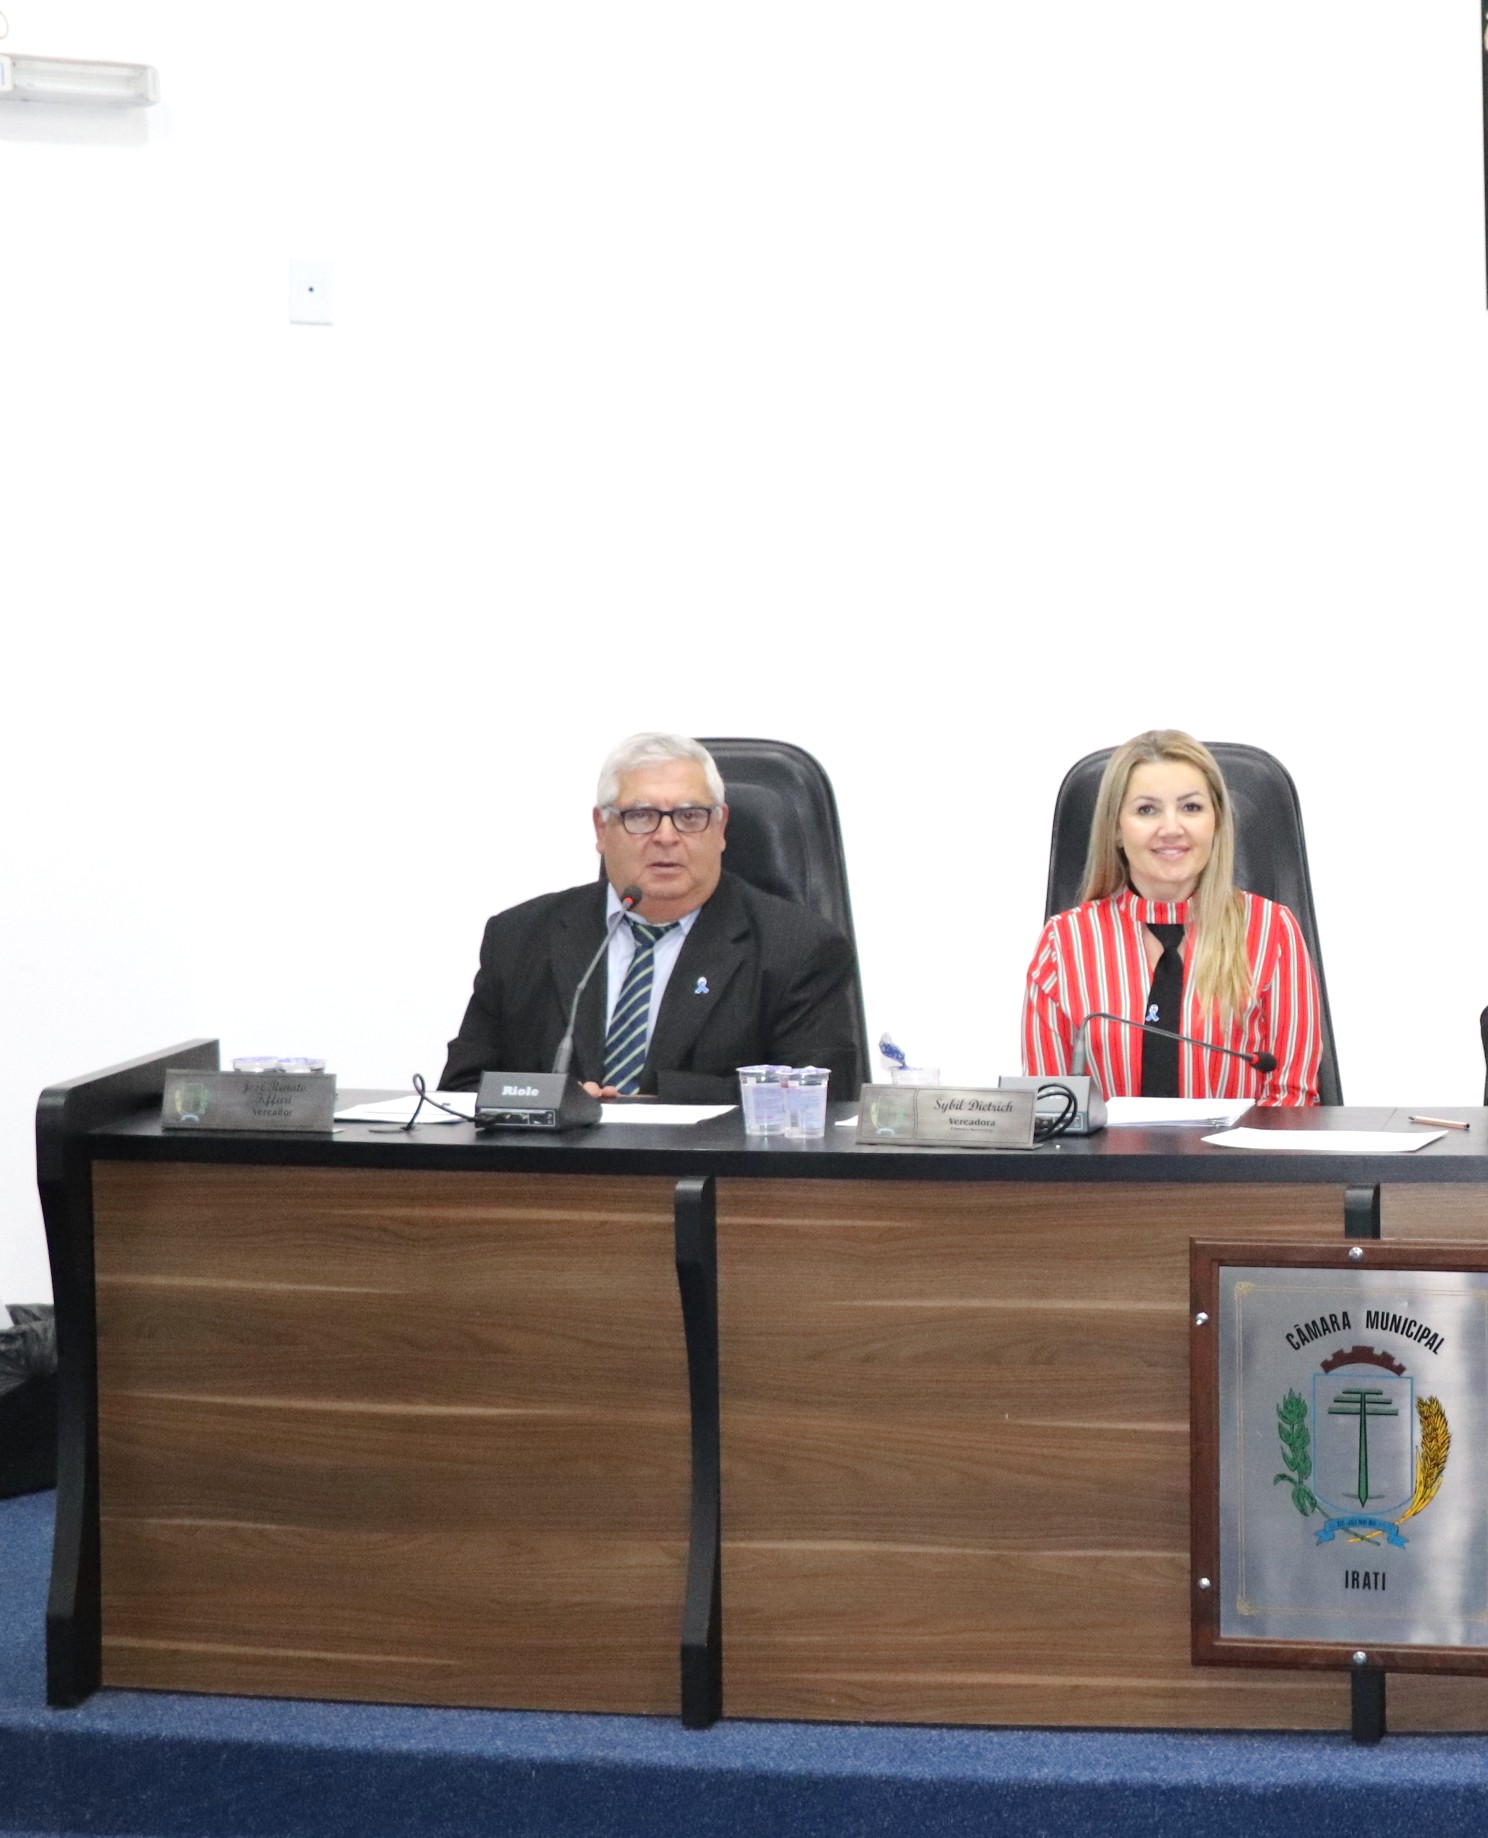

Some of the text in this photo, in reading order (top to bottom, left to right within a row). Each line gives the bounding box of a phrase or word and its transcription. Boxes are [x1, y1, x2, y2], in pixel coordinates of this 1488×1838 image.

[501, 1085, 540, 1097] Riole
[253, 1108, 293, 1117] Vereador
[933, 1099, 1013, 1113] Sybil Dietrich
[948, 1117, 996, 1127] Vereadora
[1366, 1310, 1444, 1355] MUNICIPAL
[1345, 1570, 1386, 1591] IRATI
